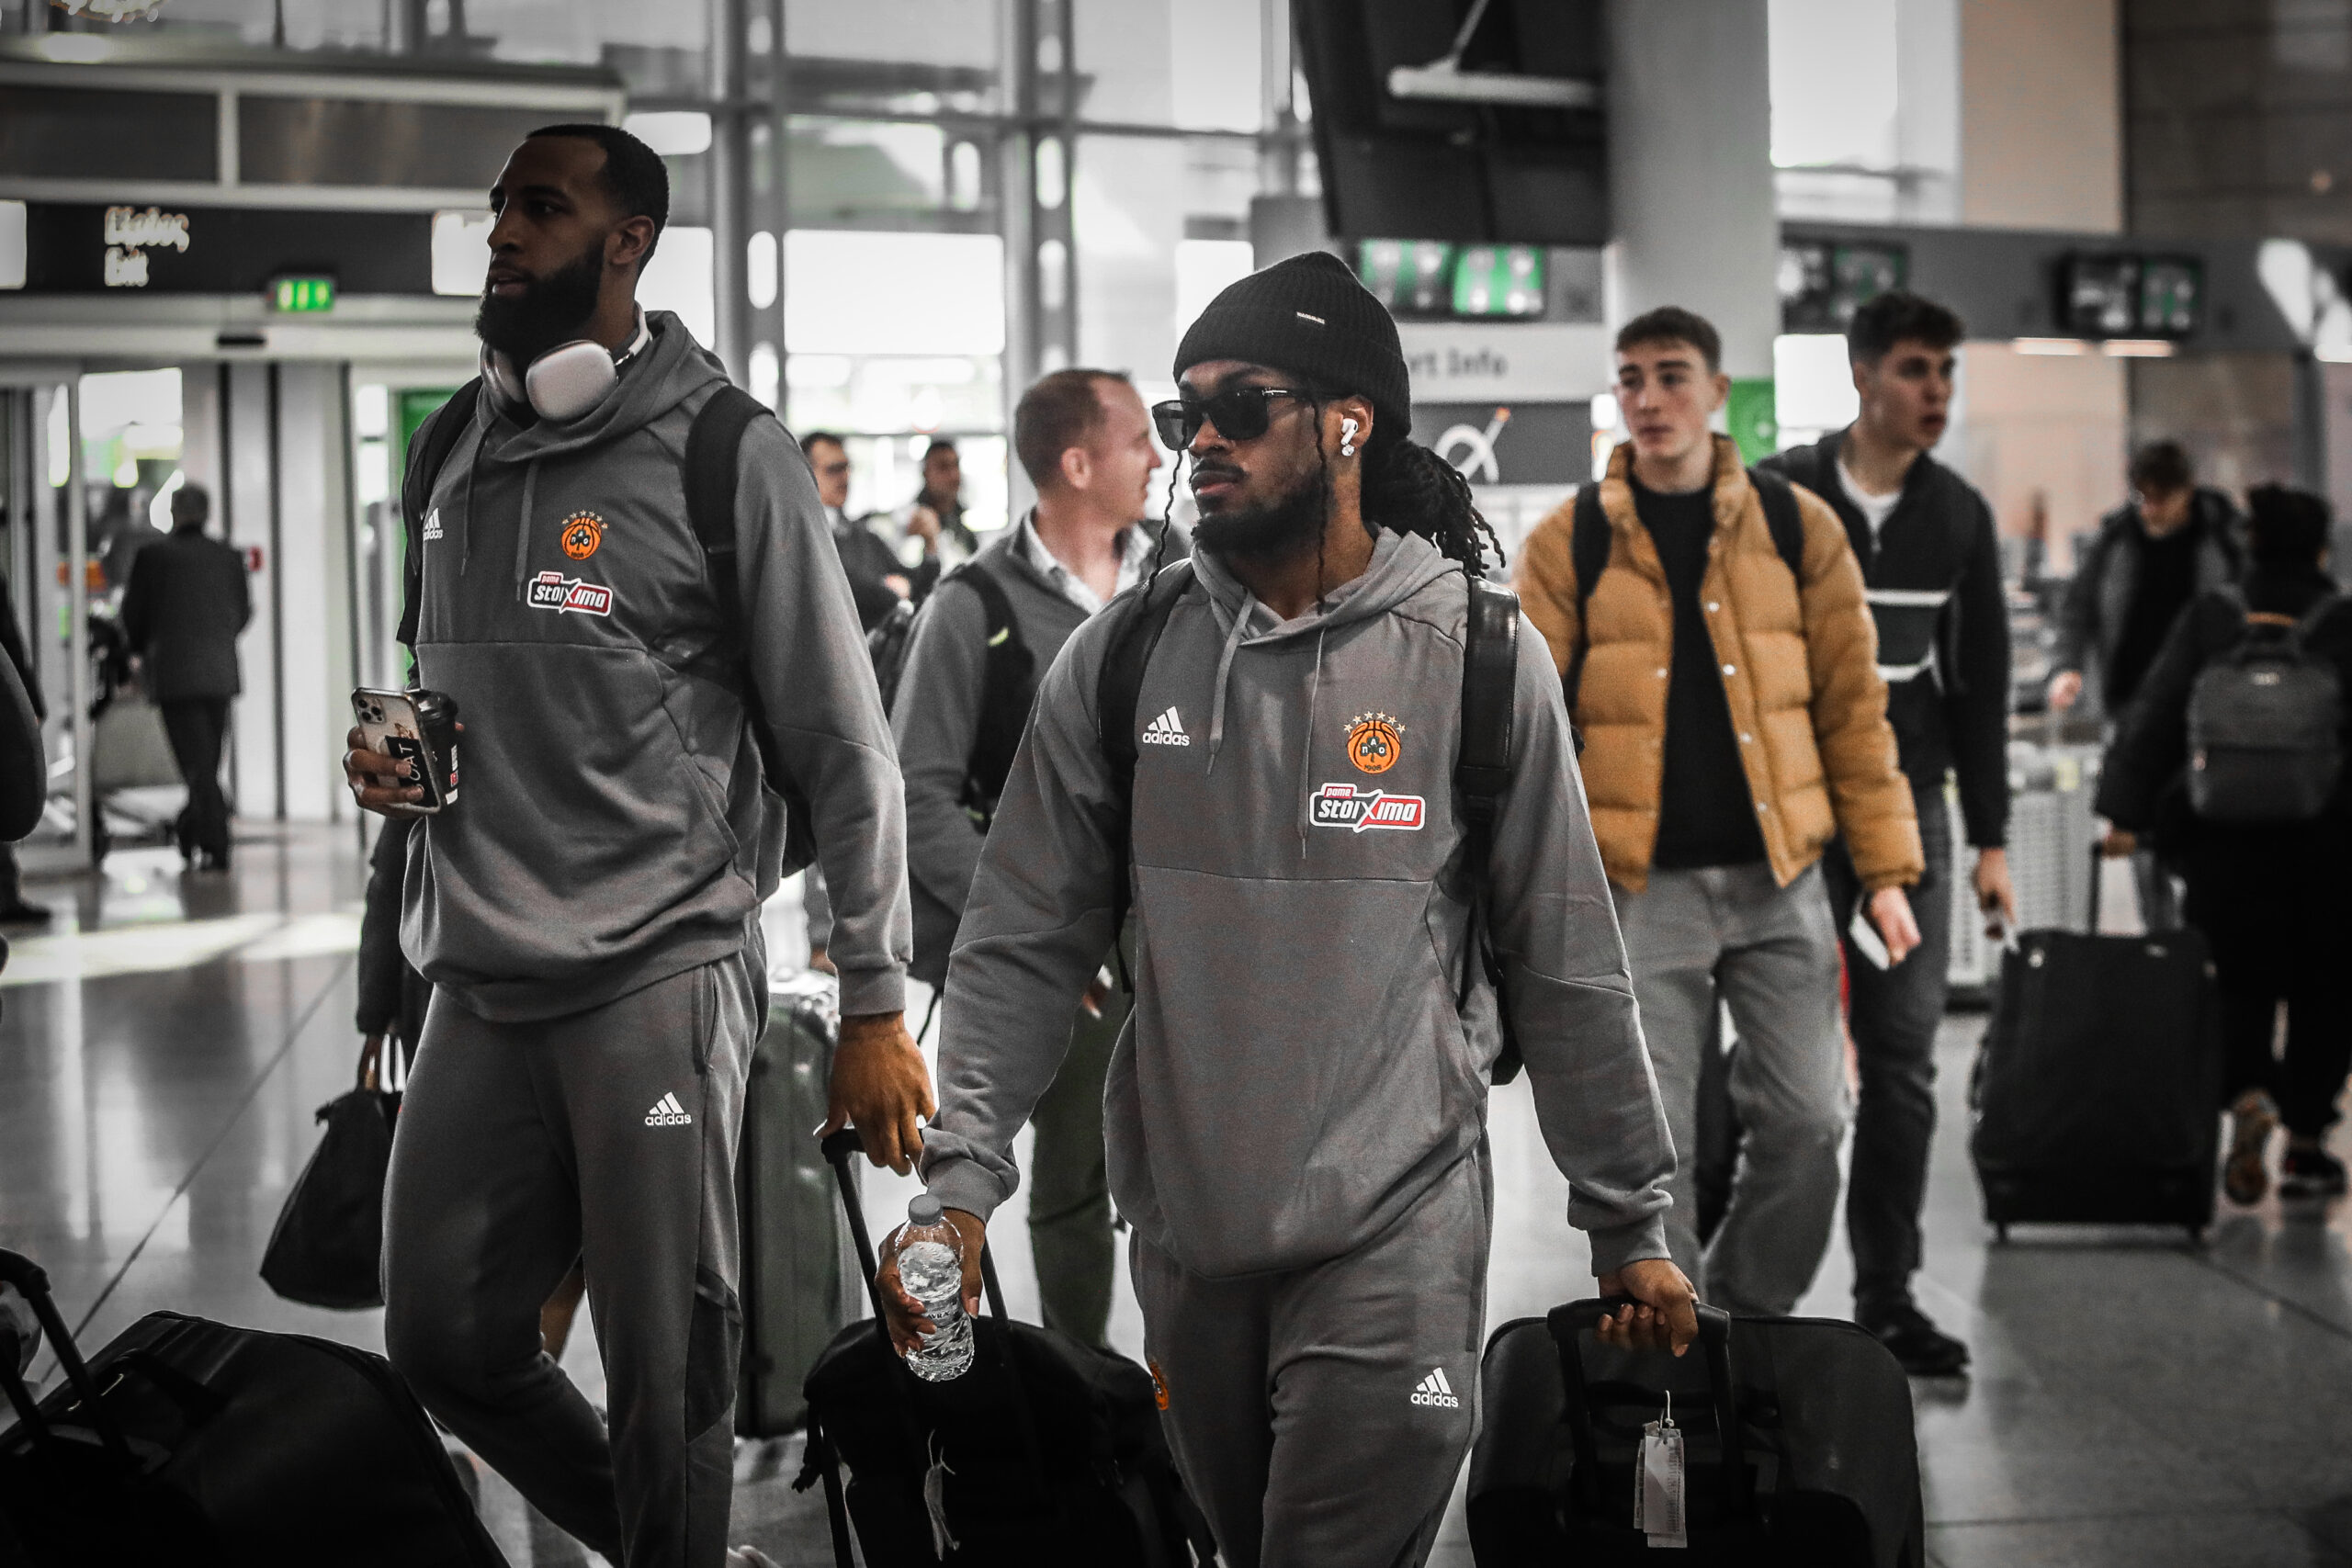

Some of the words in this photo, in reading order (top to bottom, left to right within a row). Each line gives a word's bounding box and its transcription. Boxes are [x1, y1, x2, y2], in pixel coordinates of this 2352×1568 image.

[1142, 729, 1191, 746] adidas
[399, 742, 424, 792] OAT
[1326, 787, 1351, 797] pame
[644, 1113, 693, 1126] adidas
[1410, 1391, 1459, 1408] adidas
